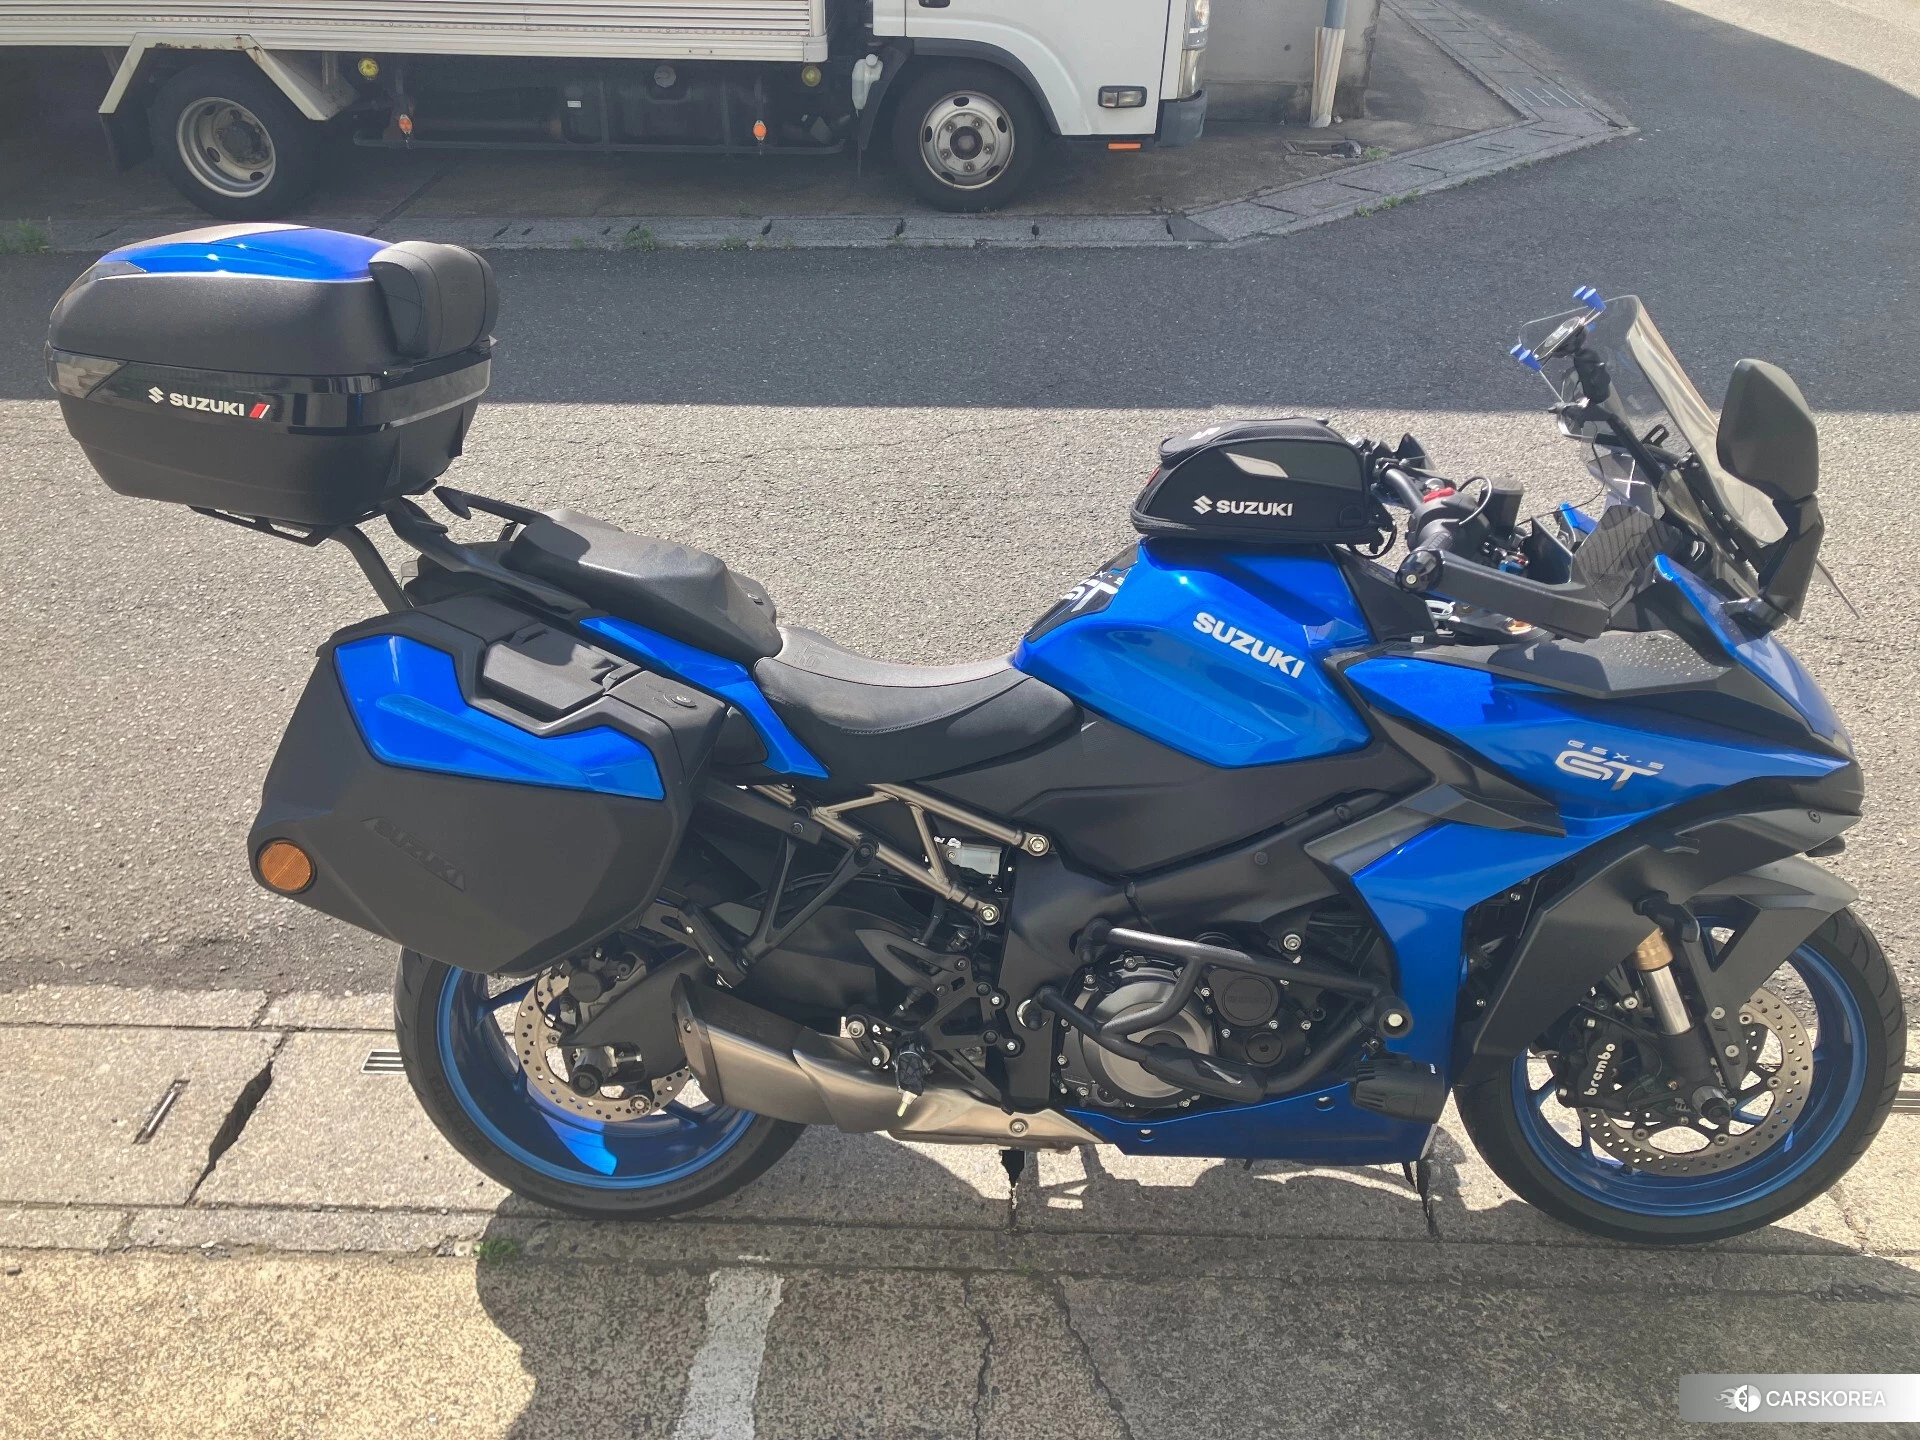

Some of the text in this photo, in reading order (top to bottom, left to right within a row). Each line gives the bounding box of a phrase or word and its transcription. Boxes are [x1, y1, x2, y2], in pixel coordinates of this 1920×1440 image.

[169, 392, 245, 417] SUZUKI
[1216, 499, 1294, 517] SUZUKI
[1192, 612, 1306, 679] SUZUKI
[1554, 750, 1660, 792] GT
[1583, 1043, 1616, 1096] brembo
